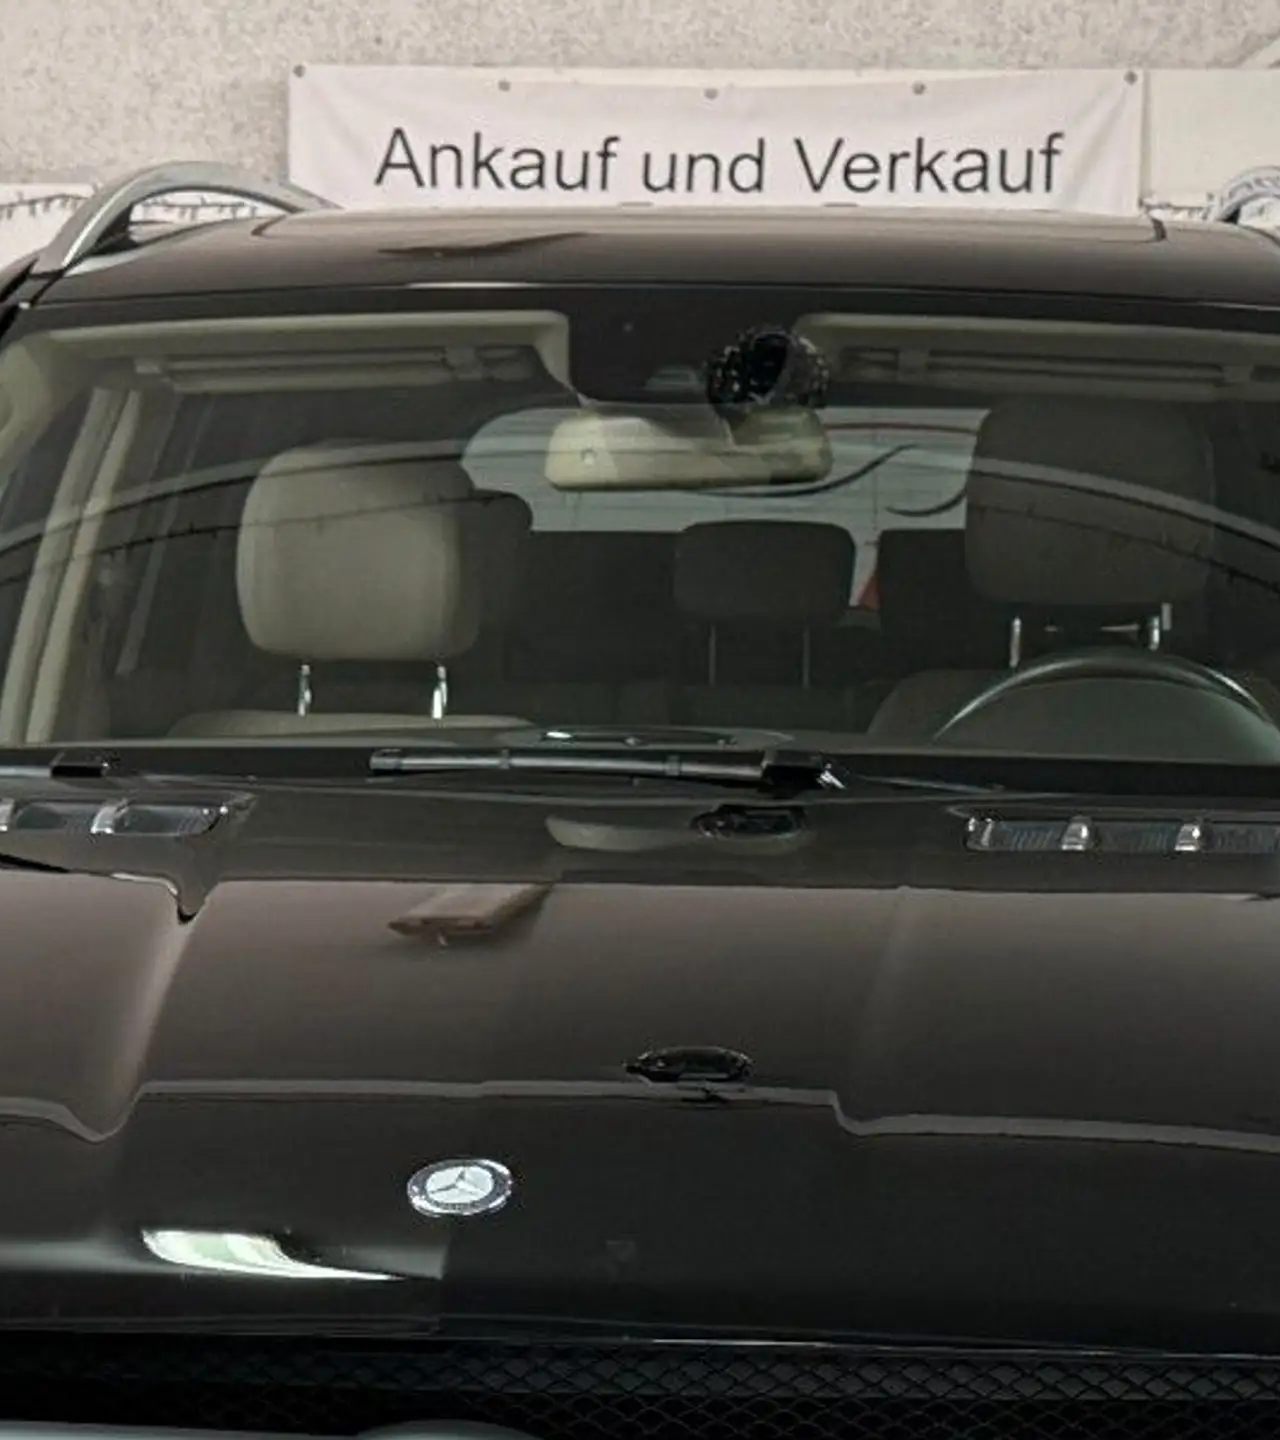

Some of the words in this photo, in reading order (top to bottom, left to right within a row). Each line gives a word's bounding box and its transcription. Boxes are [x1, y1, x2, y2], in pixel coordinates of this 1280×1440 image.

[374, 127, 622, 193] Ankauf
[641, 138, 766, 194] und
[793, 131, 1066, 194] Verkauf
